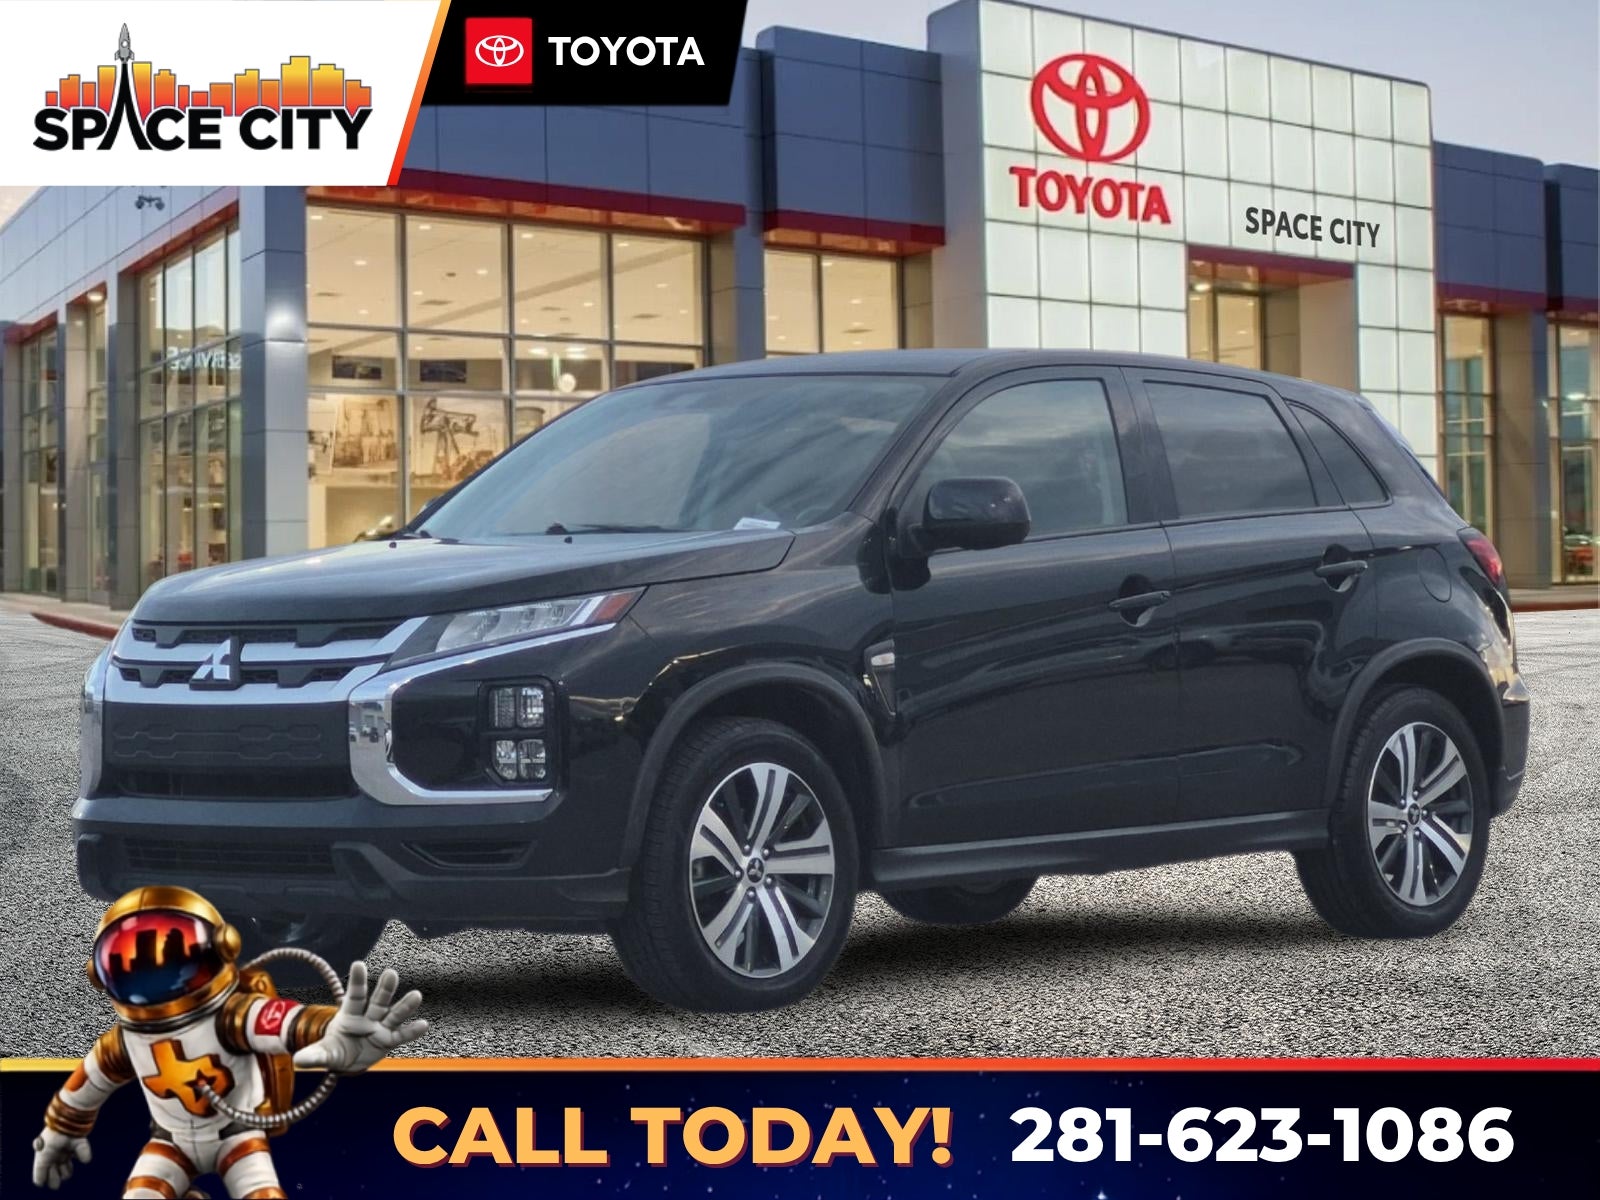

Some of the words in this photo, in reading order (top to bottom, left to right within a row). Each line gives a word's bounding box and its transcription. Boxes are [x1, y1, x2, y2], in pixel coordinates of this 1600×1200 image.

[1008, 166, 1171, 225] TOYOTA
[1244, 206, 1323, 242] SPACE
[1329, 218, 1381, 248] CITY
